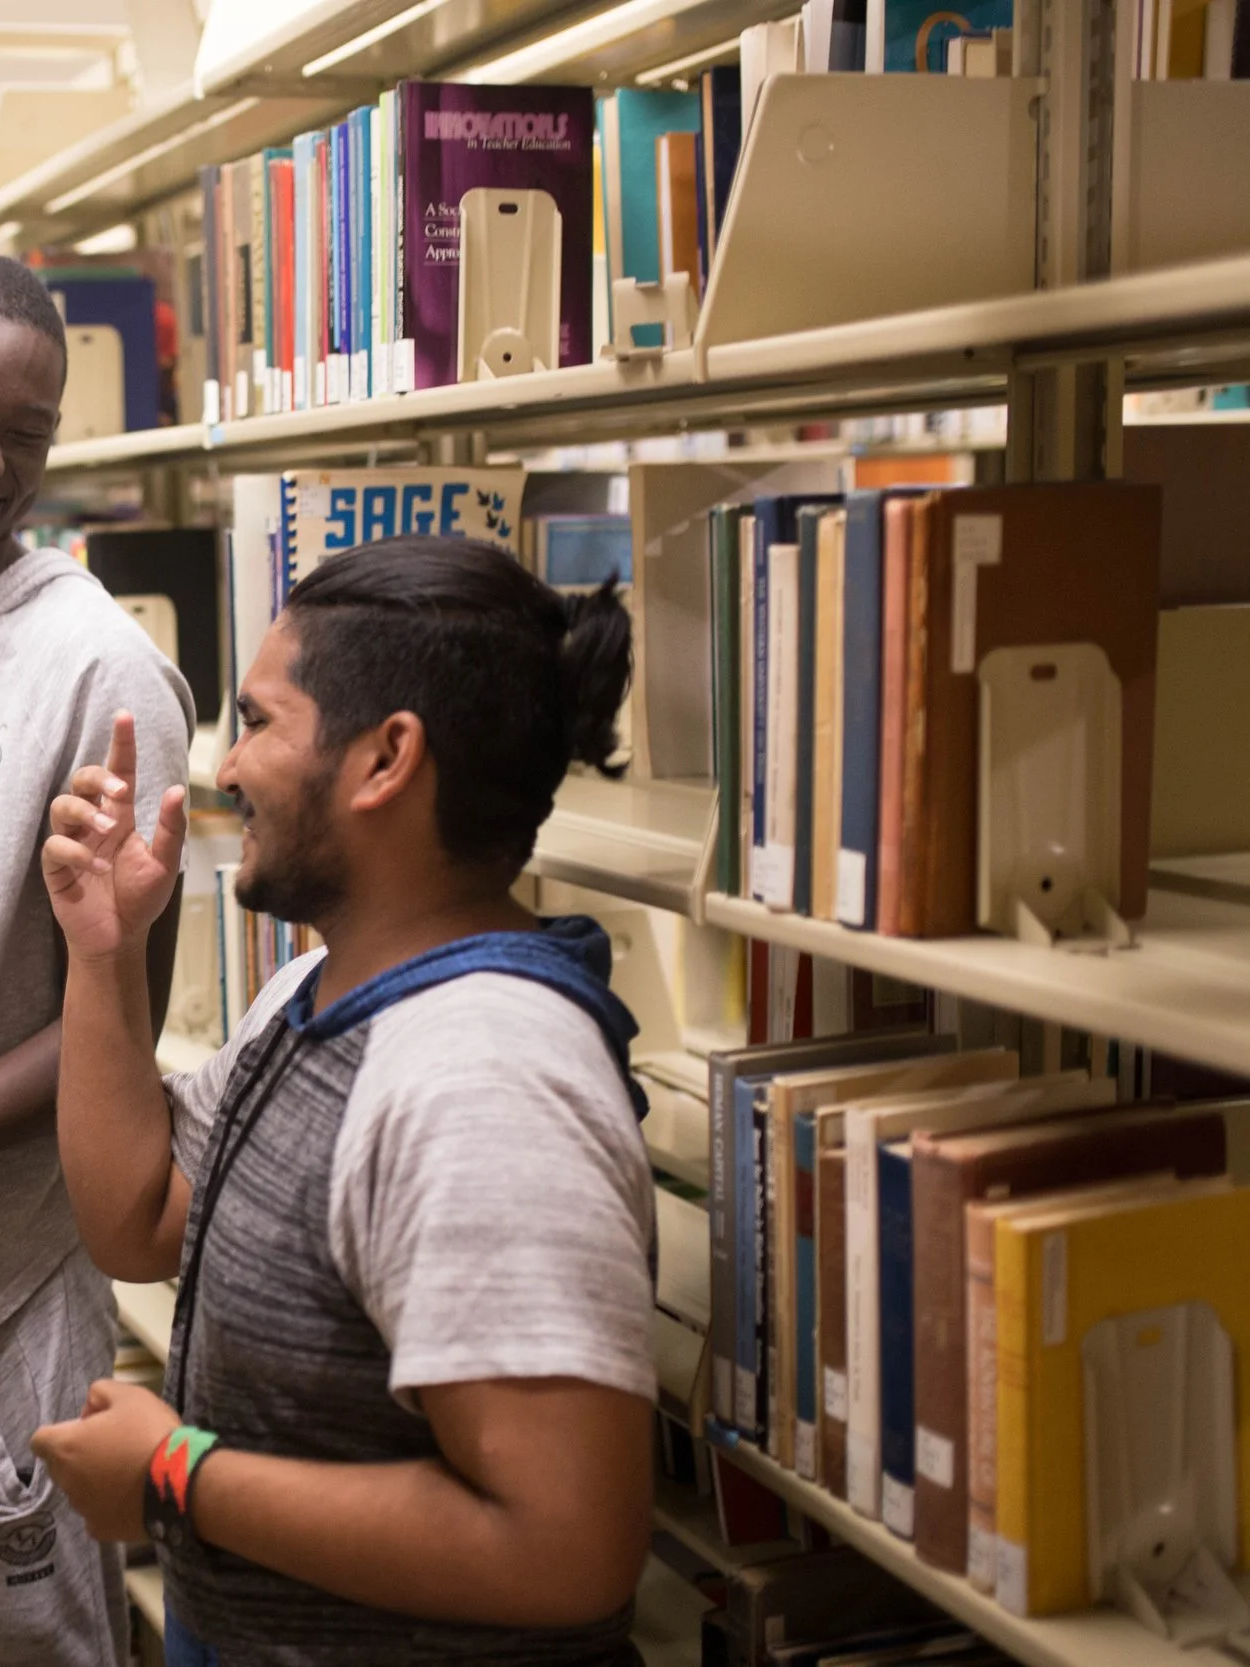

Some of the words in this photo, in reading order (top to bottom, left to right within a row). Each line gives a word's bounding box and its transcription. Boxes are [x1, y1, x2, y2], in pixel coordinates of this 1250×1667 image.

[424, 111, 569, 141] INNOVATIONS
[467, 137, 478, 150] in
[481, 137, 519, 151] Teacher
[521, 138, 572, 151] Education
[425, 202, 436, 217] A
[325, 483, 470, 549] SAGE
[713, 1073, 726, 1130] HUMAN
[713, 1137, 725, 1201] CAPITAL
